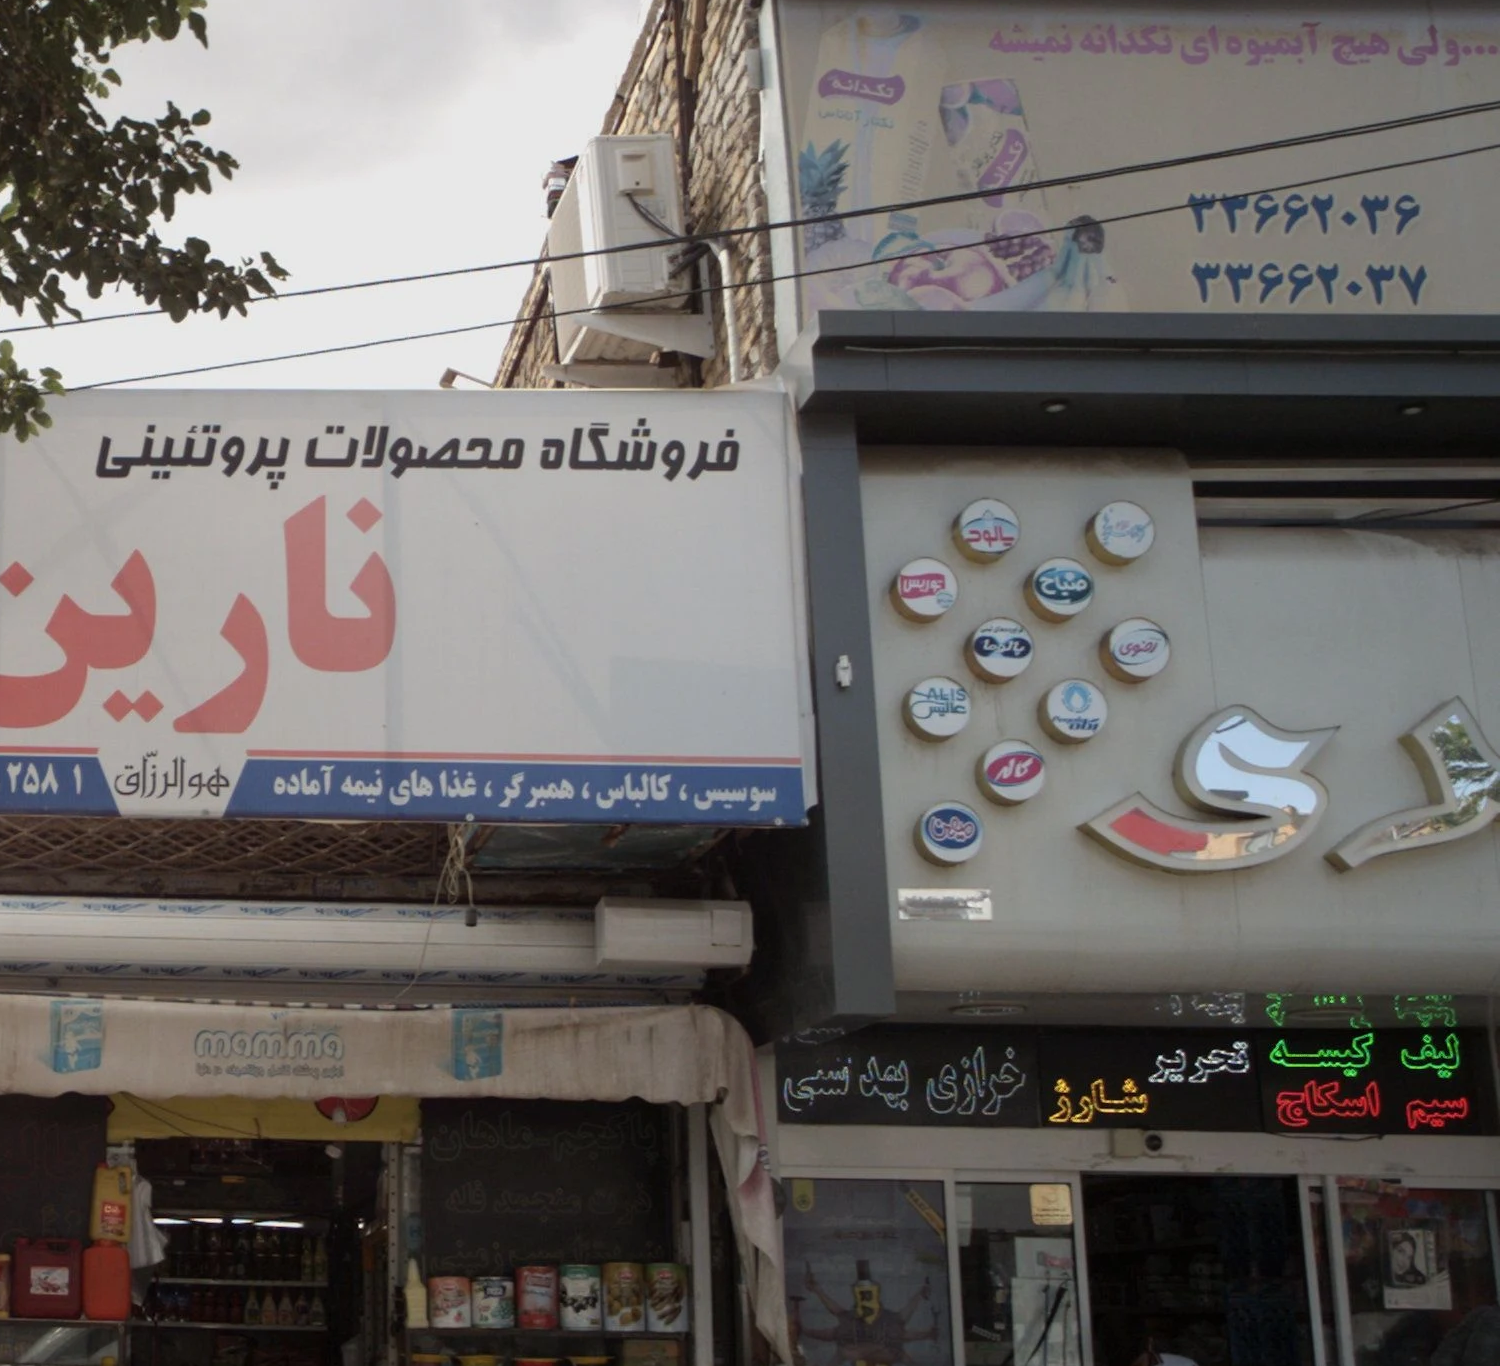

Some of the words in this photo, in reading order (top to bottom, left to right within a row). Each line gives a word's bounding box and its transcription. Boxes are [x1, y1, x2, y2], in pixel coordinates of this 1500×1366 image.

[988, 24, 1074, 62] نمیشه
[1080, 23, 1172, 55] تکدانه
[1330, 33, 1390, 65] هیچ
[830, 77, 896, 99] تکدانه
[1188, 193, 1421, 235] ۳۳۶۶۲۰۳۶
[1191, 263, 1428, 305] ۳۳۶۶۲۰۳۷
[96, 424, 291, 489] پروتئینی
[304, 424, 524, 479] محصولات
[539, 418, 740, 482] فروشگاه
[927, 686, 967, 702] ALIS
[273, 765, 335, 798] آماده
[339, 774, 384, 805] نیمه
[195, 1028, 344, 1062] mamma
[1148, 1041, 1250, 1083] تحریر
[1270, 1032, 1374, 1077] کیسه
[1400, 1032, 1460, 1078] لیف
[927, 1046, 1027, 1114] خرازی
[1048, 1078, 1149, 1123] شارژ
[1406, 1097, 1470, 1129] سیم
